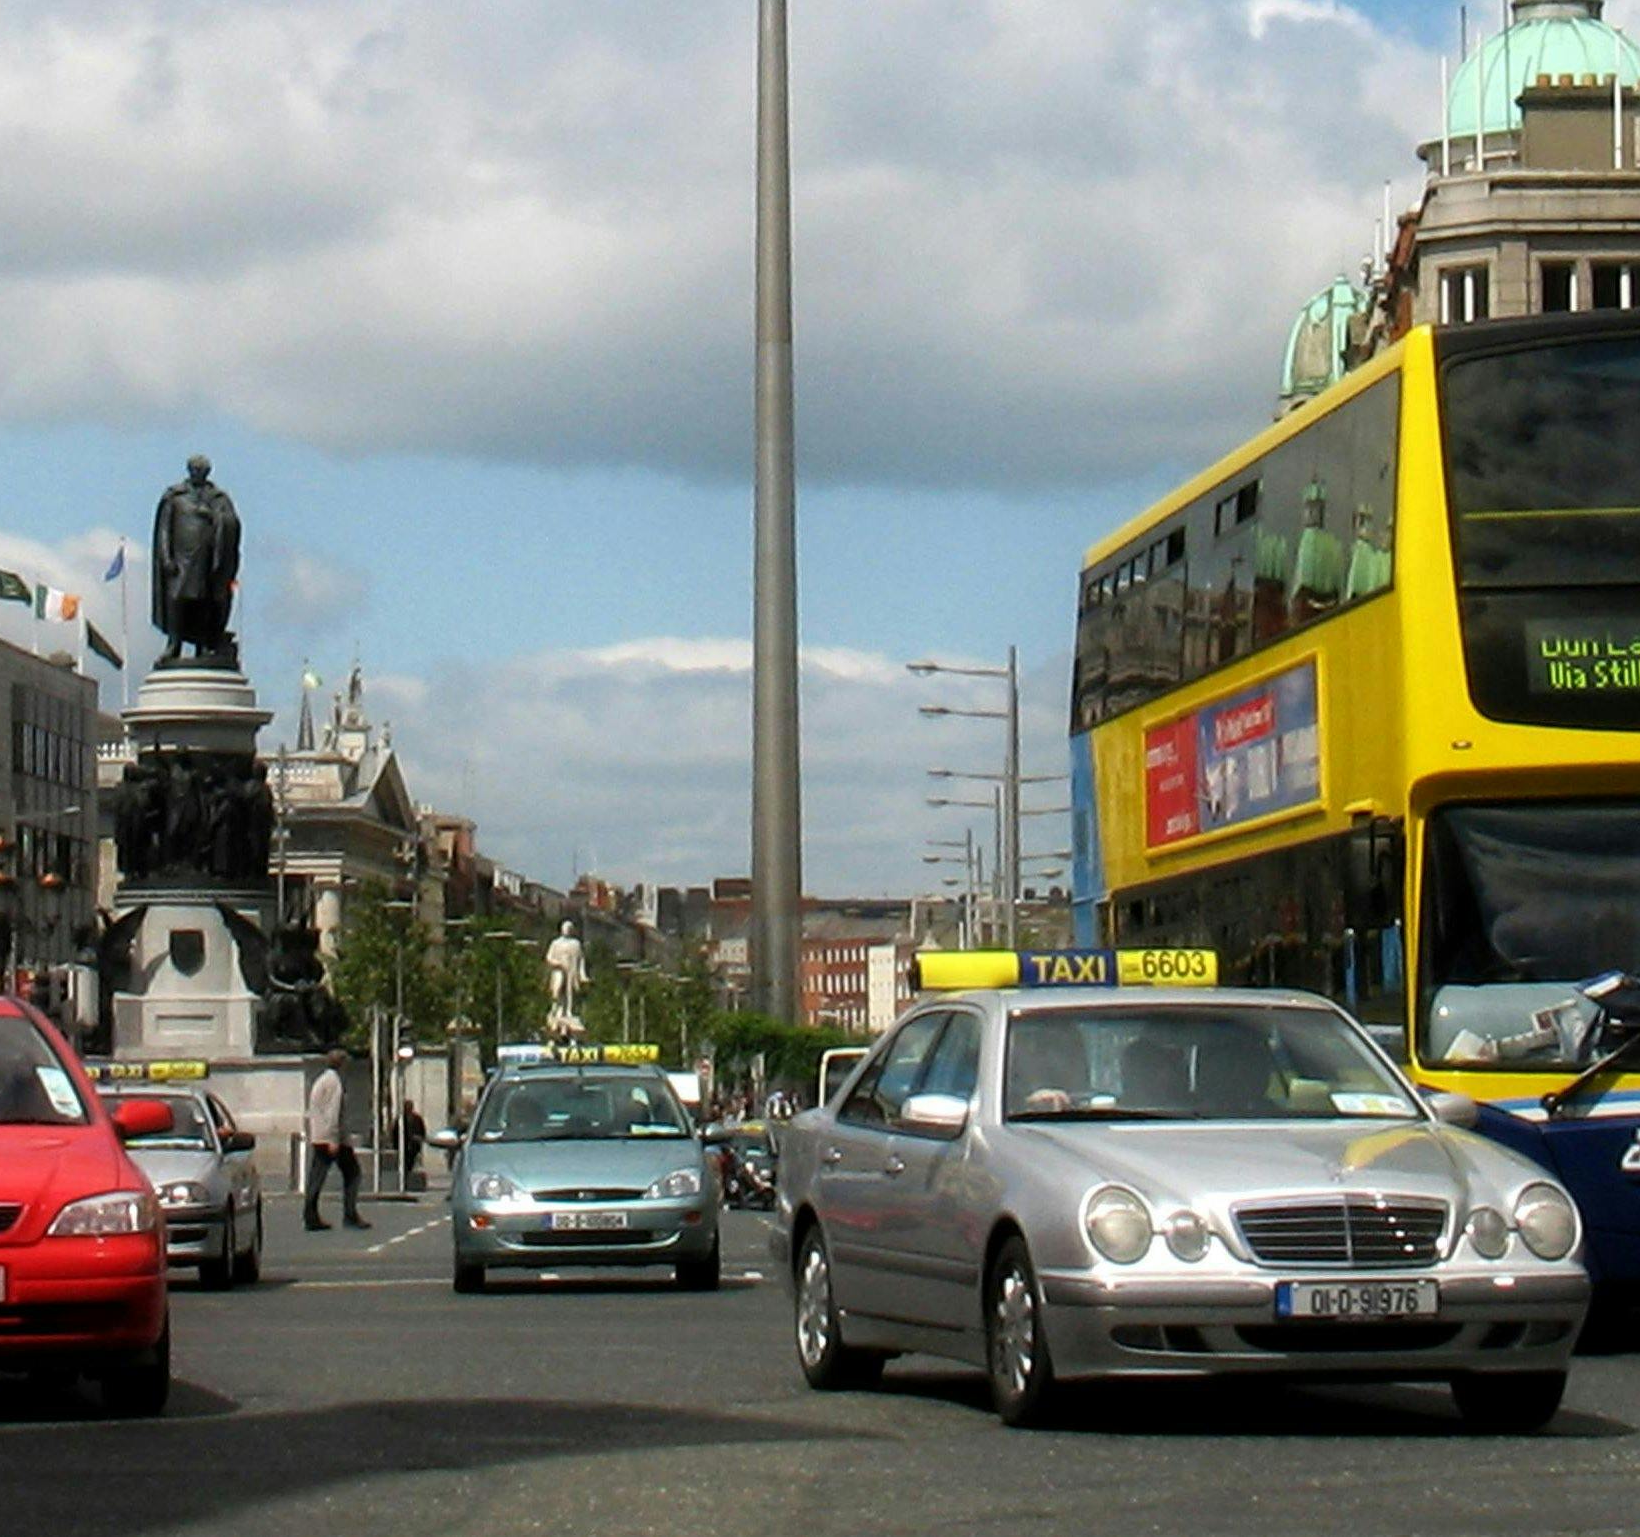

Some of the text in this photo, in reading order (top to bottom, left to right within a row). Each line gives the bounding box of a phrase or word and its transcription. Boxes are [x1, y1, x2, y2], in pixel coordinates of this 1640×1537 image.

[1549, 662, 1587, 689] Via
[1029, 955, 1107, 983] TAXI
[1141, 949, 1206, 978] 6603
[560, 1046, 599, 1062] TAXI
